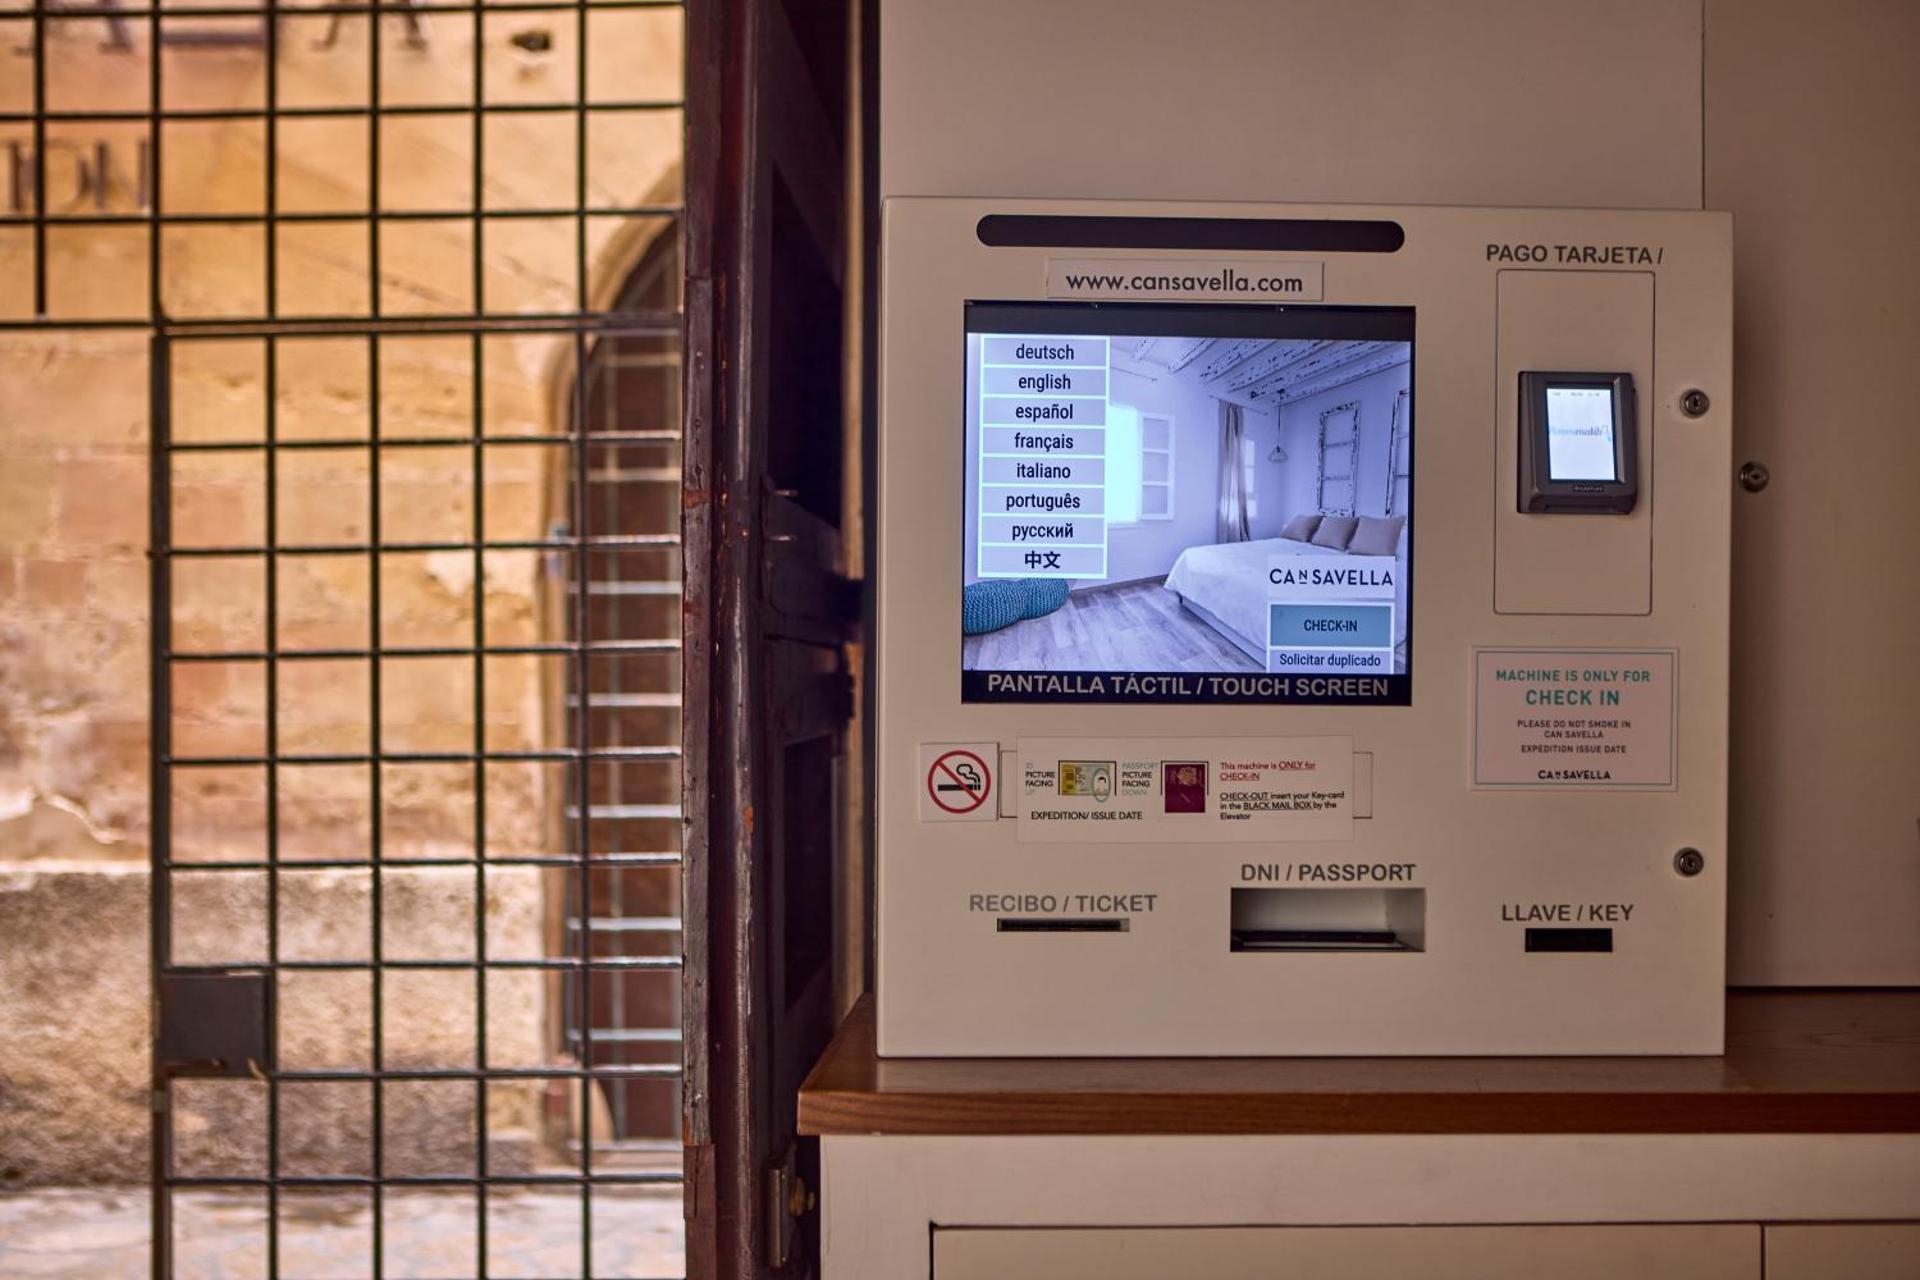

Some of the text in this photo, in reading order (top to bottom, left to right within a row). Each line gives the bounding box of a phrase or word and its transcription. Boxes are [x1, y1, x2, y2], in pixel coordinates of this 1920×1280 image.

[1486, 244, 1664, 264] PAGO TARJETA /
[1066, 270, 1303, 292] www.cansavella.com
[1015, 344, 1074, 360] deutsch
[1018, 374, 1071, 392] english
[1015, 403, 1073, 422] español
[1015, 433, 1074, 452] français
[1016, 462, 1070, 479] italiano
[1006, 493, 1080, 511] português
[1012, 522, 1073, 540] русский
[1025, 551, 1060, 569] 中文
[1312, 568, 1393, 586] SAVELLA
[1304, 619, 1358, 633] CHECK-IN
[1279, 654, 1381, 667] Solicitar duplicado
[989, 673, 1388, 696] PANTALLA TÁCTIL / TOUCH SCREEN
[1497, 670, 1651, 682] MACHINE IS ONLY FOR
[1526, 690, 1620, 705] CHECK IN
[1564, 771, 1610, 779] SAVELLA
[1313, 802, 1322, 810] by
[1242, 864, 1416, 882] DNI / PASSPORT
[970, 894, 1157, 913] RECIBO / TICKET
[1502, 905, 1634, 921] LLAVE / KEY
